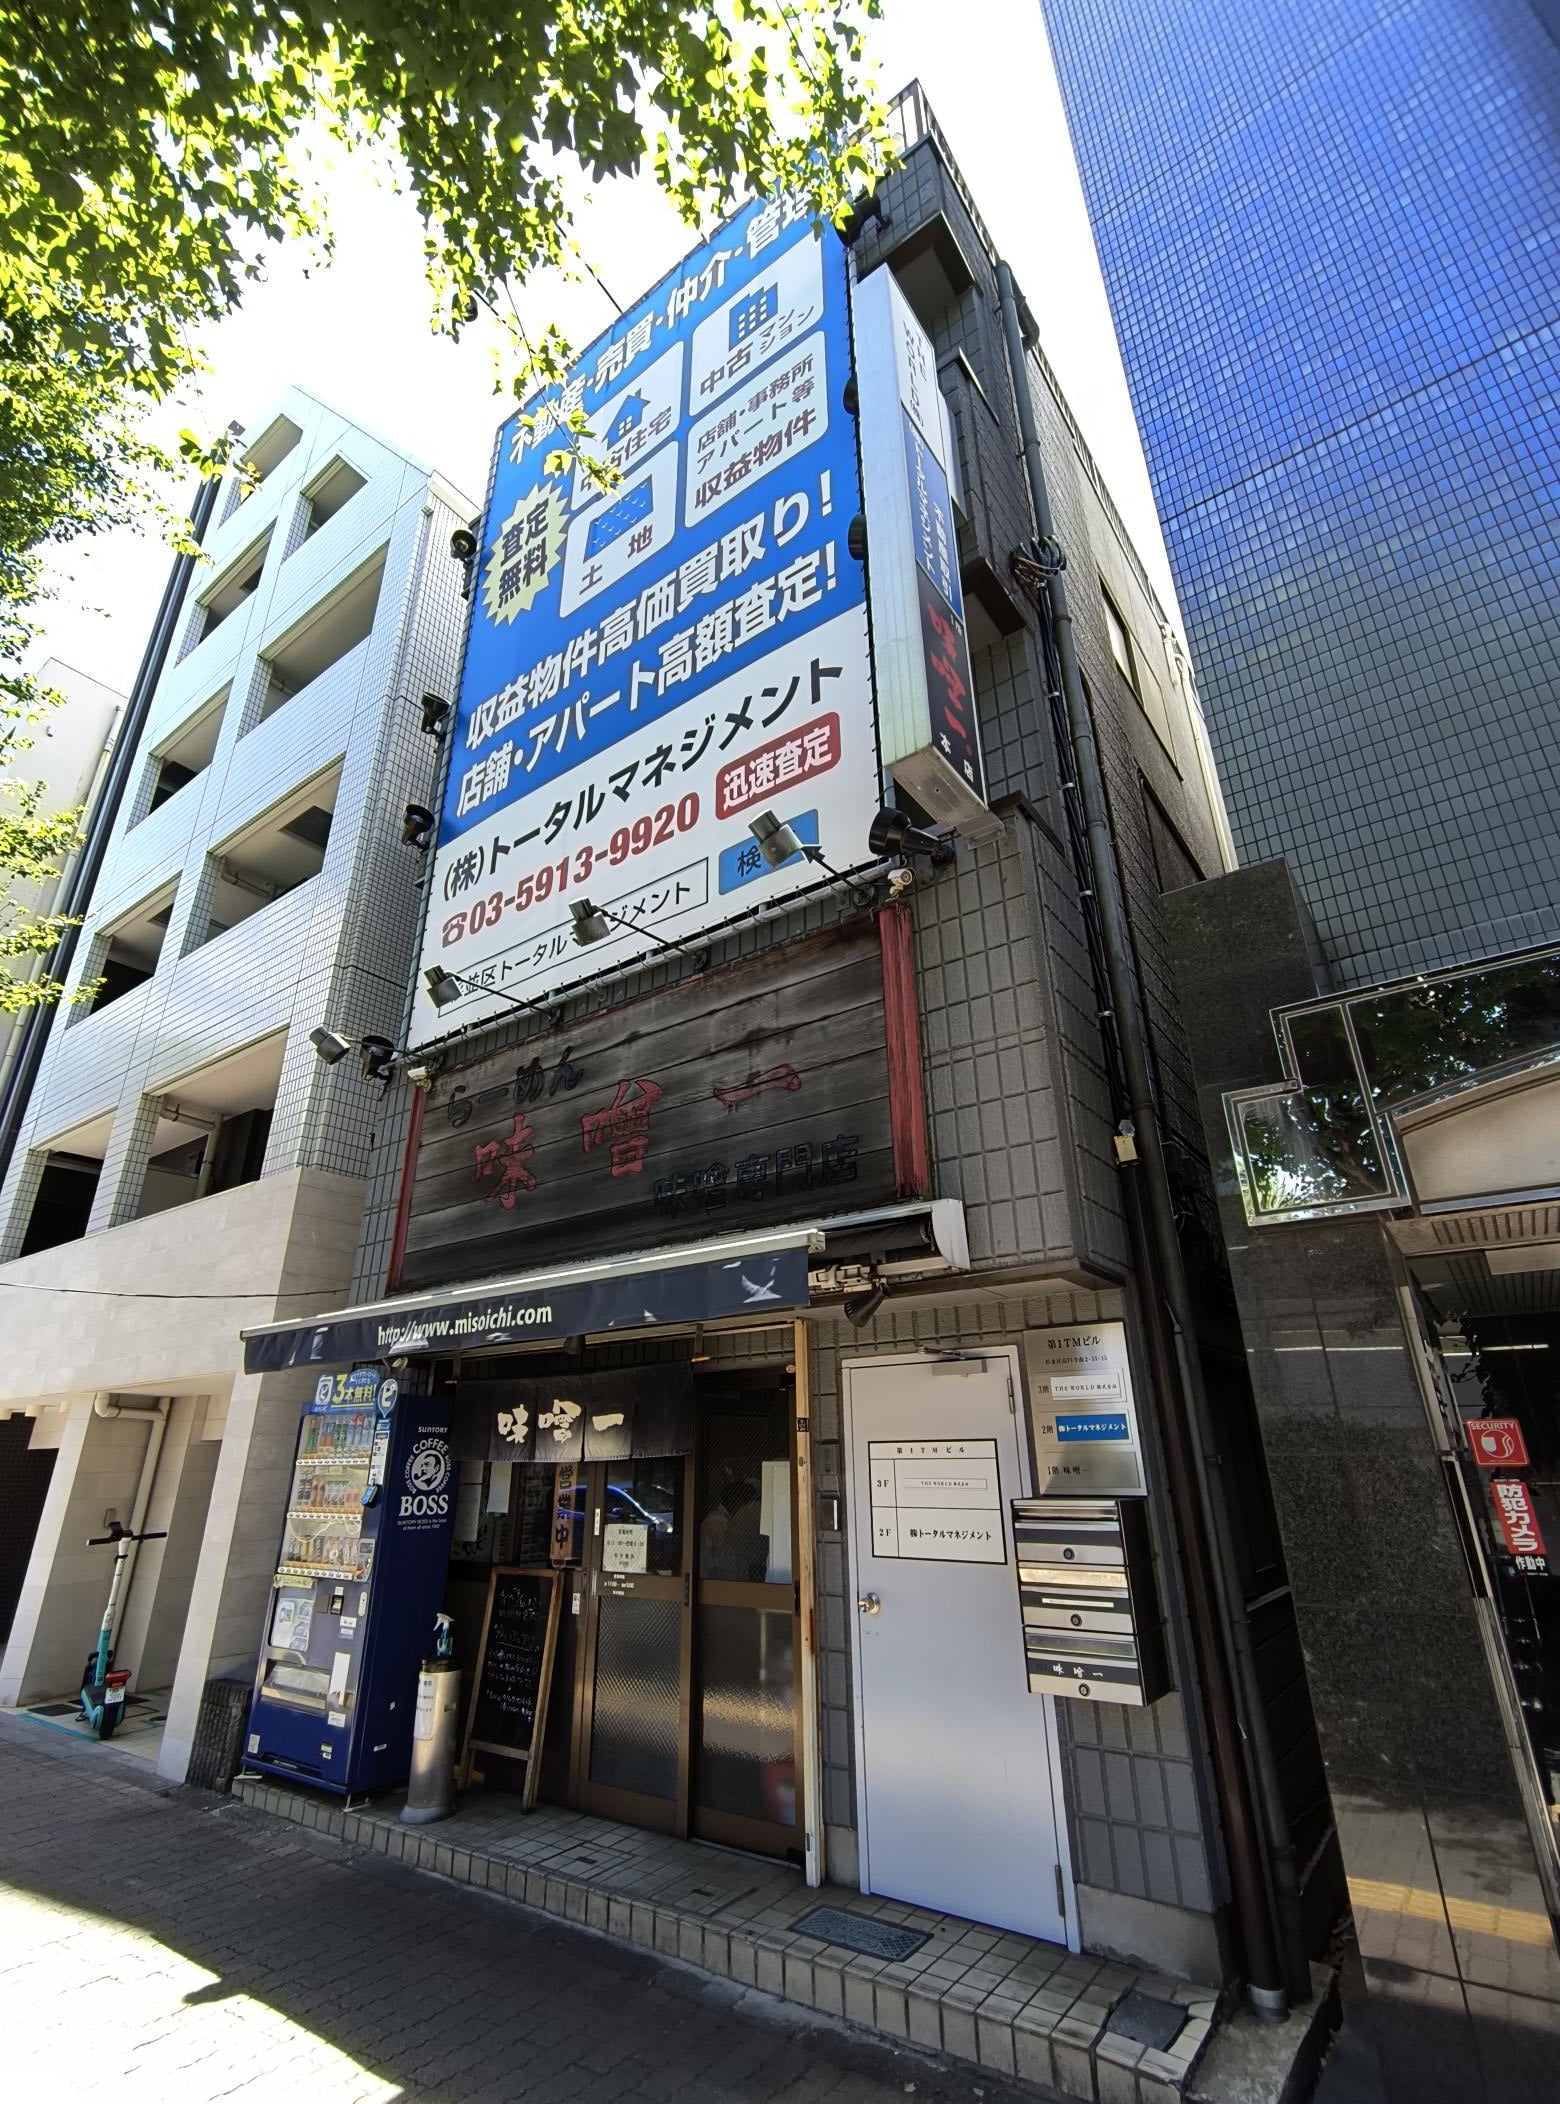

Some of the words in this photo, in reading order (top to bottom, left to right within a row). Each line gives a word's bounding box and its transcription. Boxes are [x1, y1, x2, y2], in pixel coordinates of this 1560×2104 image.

[698, 353, 813, 453] 店舗・事務所
[700, 341, 754, 396] 中古
[695, 408, 817, 510] 収益物件
[697, 376, 815, 475] アパート等
[500, 497, 549, 567] 査定
[466, 469, 833, 750] 収益物件高価買取り!
[497, 536, 547, 609] 無料
[456, 541, 838, 818] 店舗・アパート高額査定!
[443, 657, 843, 901] (株)トータルマネジメント
[722, 726, 833, 813] 迅速査定
[469, 791, 701, 936] 03-5913-9920
[447, 1045, 585, 1128] らーめん
[377, 1304, 553, 1346] http://www.misoichi.com
[412, 1438, 449, 1455] COFFEE
[1470, 1421, 1514, 1431] SECURITY
[399, 1494, 449, 1517] BOSS
[1496, 1484, 1538, 1553] 防犯カメラ
[1515, 1555, 1545, 1571] 作動中
